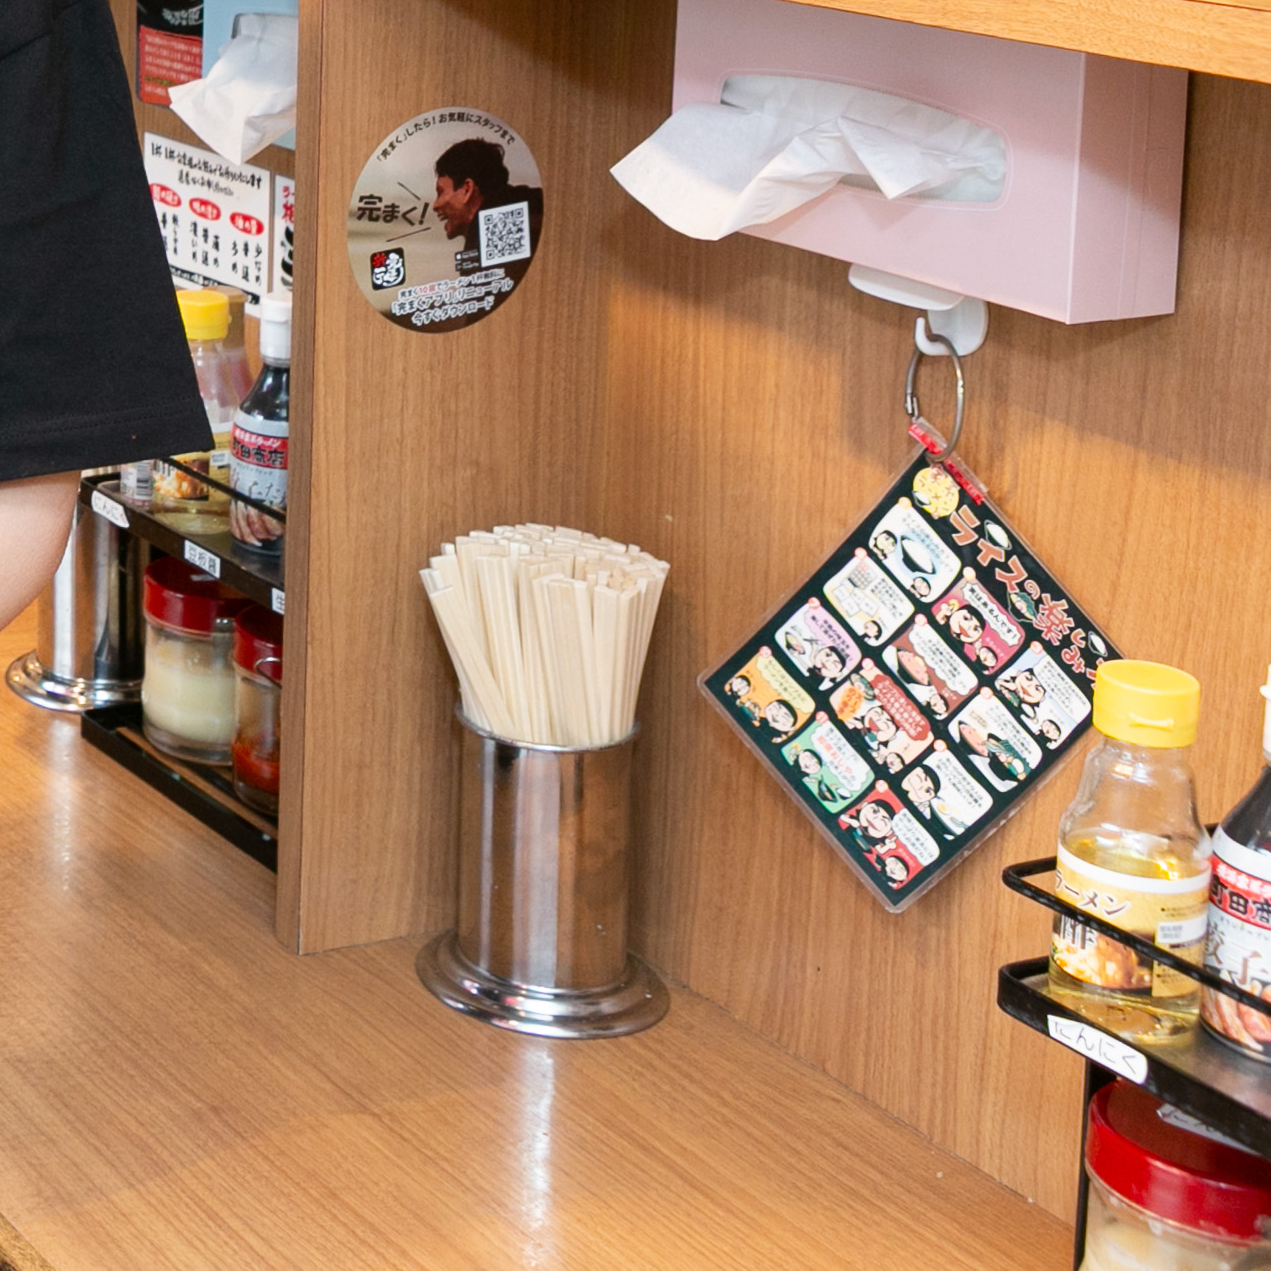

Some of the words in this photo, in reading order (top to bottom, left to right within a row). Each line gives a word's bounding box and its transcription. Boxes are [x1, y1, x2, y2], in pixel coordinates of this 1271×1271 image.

[952, 505, 1099, 687] ライスの楽しみ
[1054, 1021, 1137, 1076] にんにく
